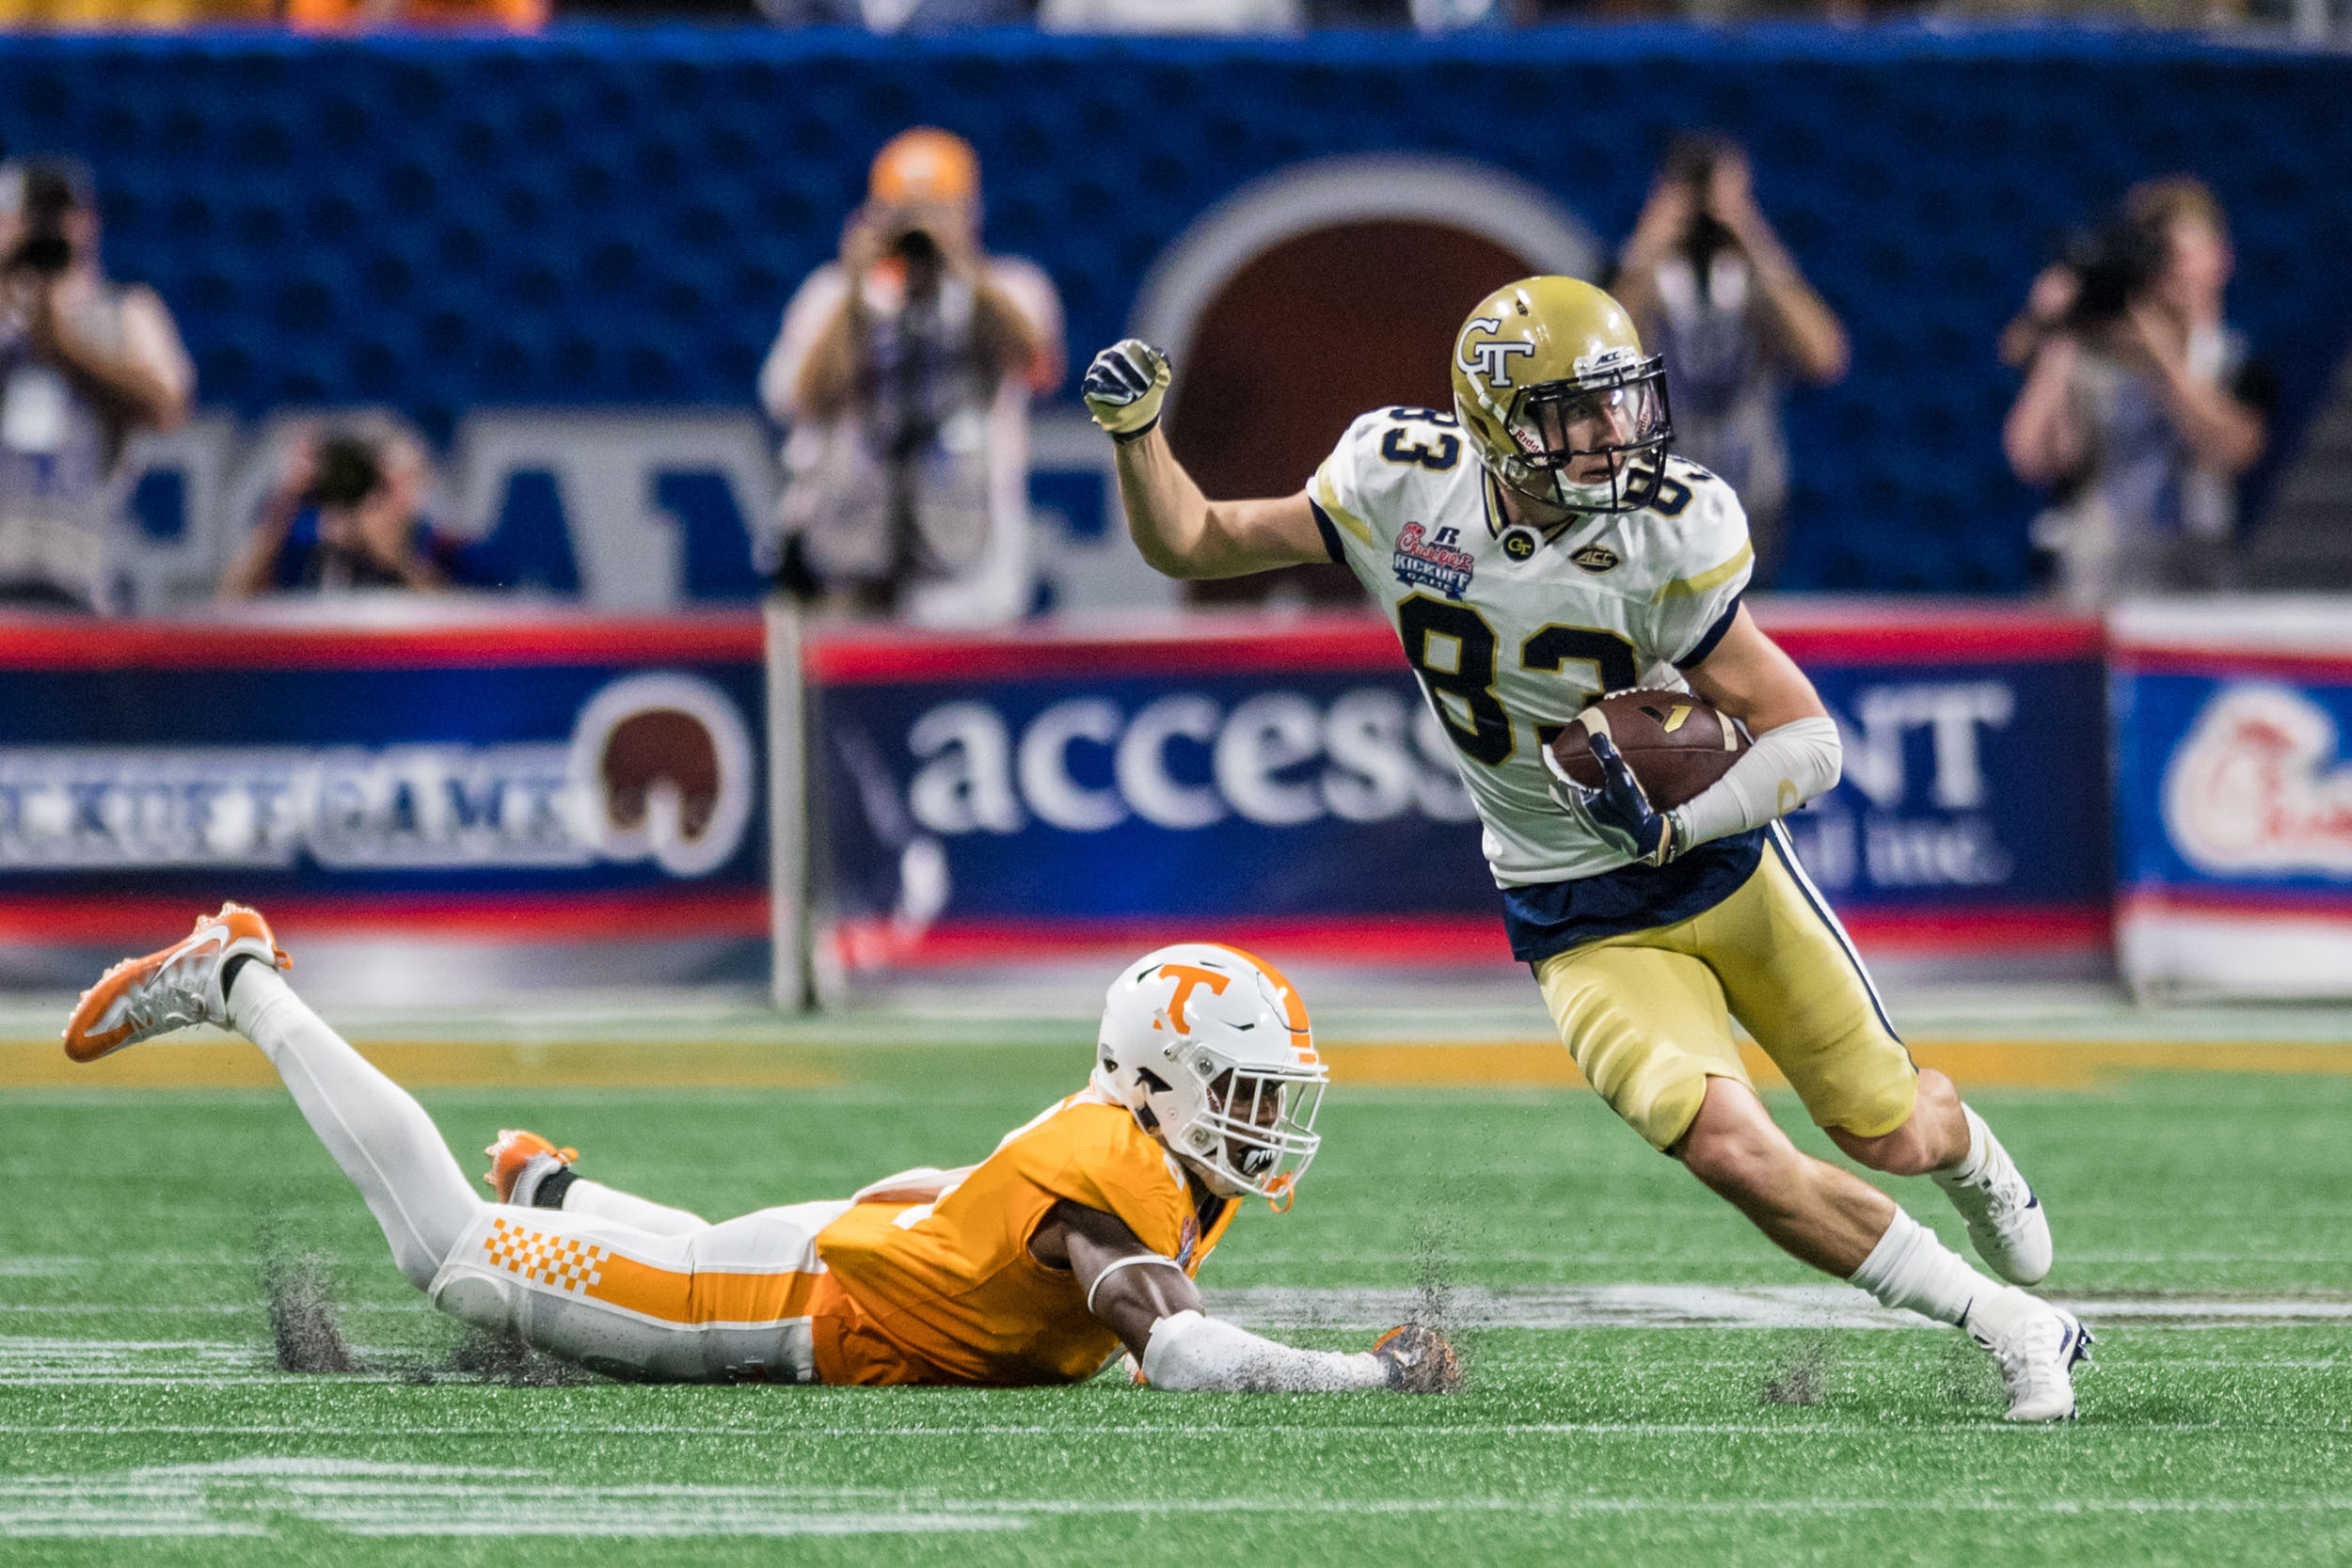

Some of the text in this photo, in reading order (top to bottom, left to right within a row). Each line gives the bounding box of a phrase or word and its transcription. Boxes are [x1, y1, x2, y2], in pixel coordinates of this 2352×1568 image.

[1456, 318, 1534, 388] GT
[1595, 350, 1621, 366] ACC
[1516, 429, 1544, 453] Ridd
[1575, 549, 1613, 564] ACC
[1152, 963, 1231, 1036] T
